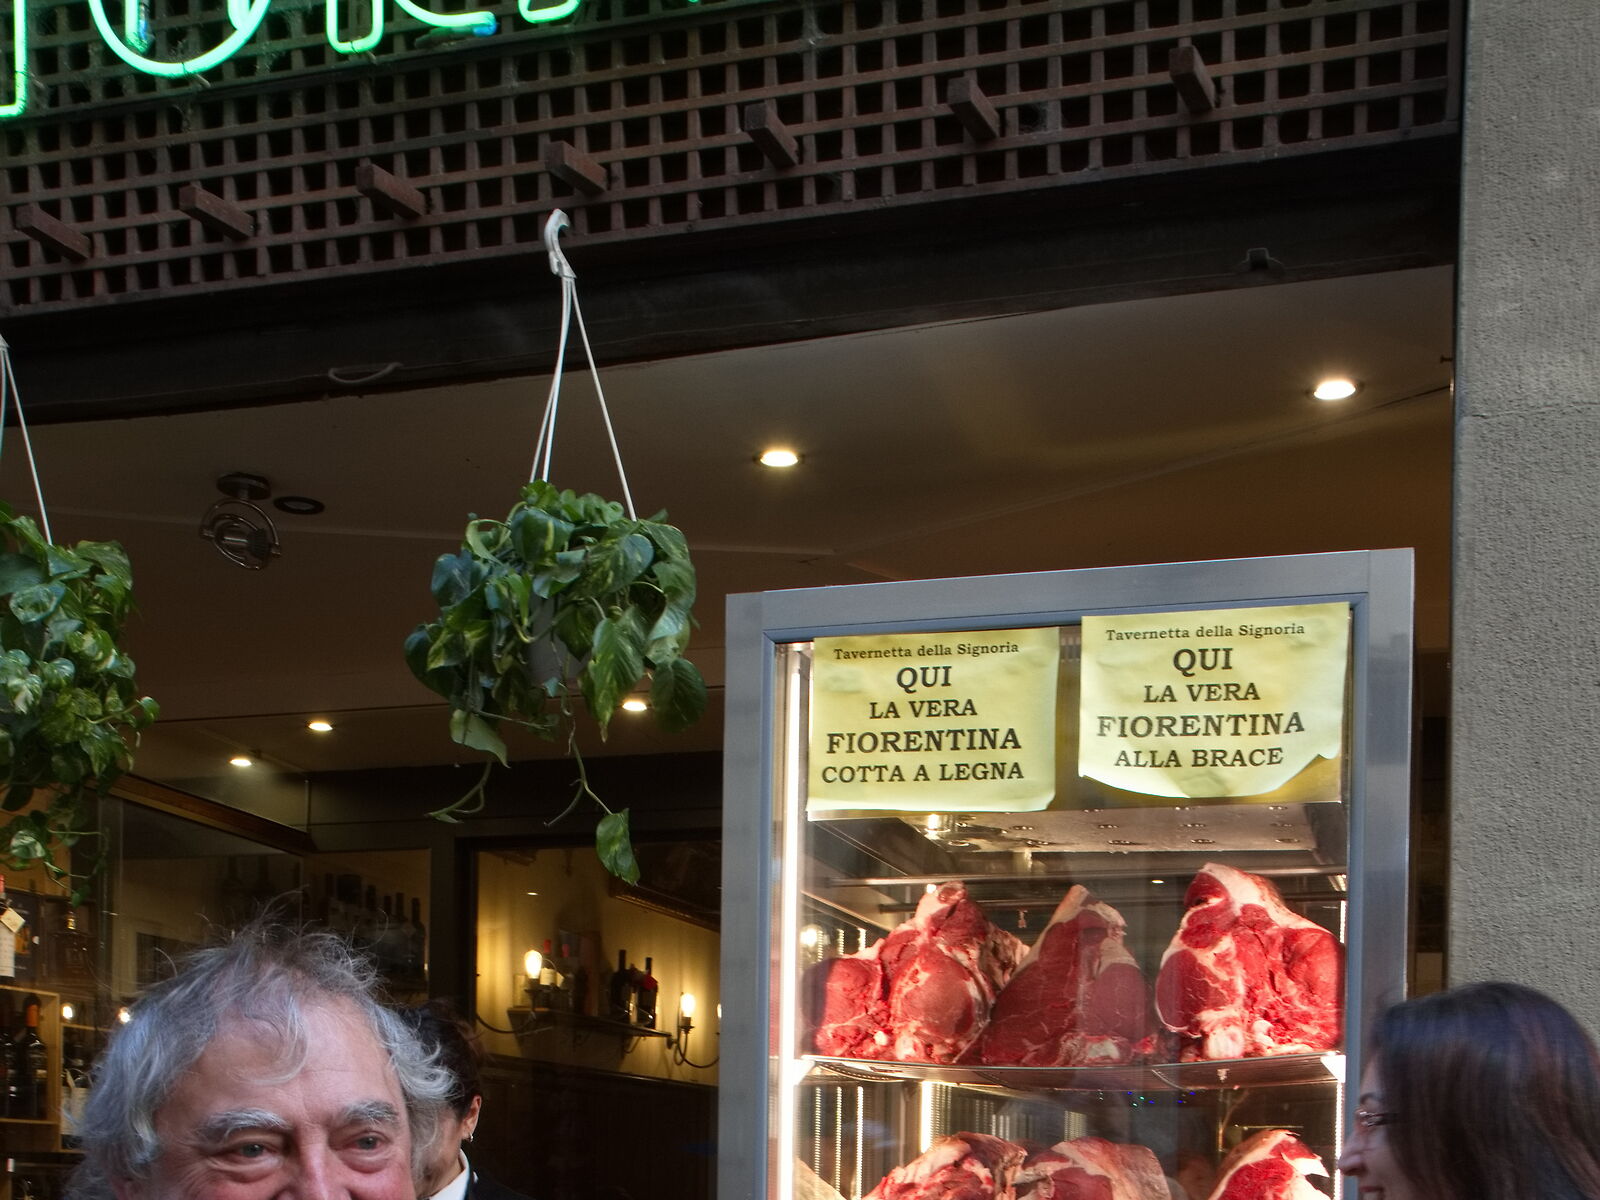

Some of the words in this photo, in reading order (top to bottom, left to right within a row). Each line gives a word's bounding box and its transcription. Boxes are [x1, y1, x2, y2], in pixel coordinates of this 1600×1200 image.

[1106, 628, 1190, 641] Tavernetta
[1196, 625, 1232, 638] della
[1239, 623, 1305, 639] Signoria
[833, 645, 912, 660] Tavernetta
[917, 643, 952, 656] della
[957, 641, 1020, 658] Signoria
[1173, 647, 1233, 677] QUI
[896, 665, 953, 694] QUI
[1143, 684, 1178, 703] LA
[1186, 682, 1261, 702] VERA
[869, 701, 900, 719] LA
[908, 698, 978, 718] VERA
[1096, 711, 1305, 738] FIORENTINA
[826, 728, 1022, 754] FIORENTINA
[1114, 749, 1181, 767] ALLA
[1191, 747, 1284, 767] BRACE
[822, 765, 905, 783] COTTA
[912, 764, 931, 782] A
[939, 762, 1025, 782] LEGNA
